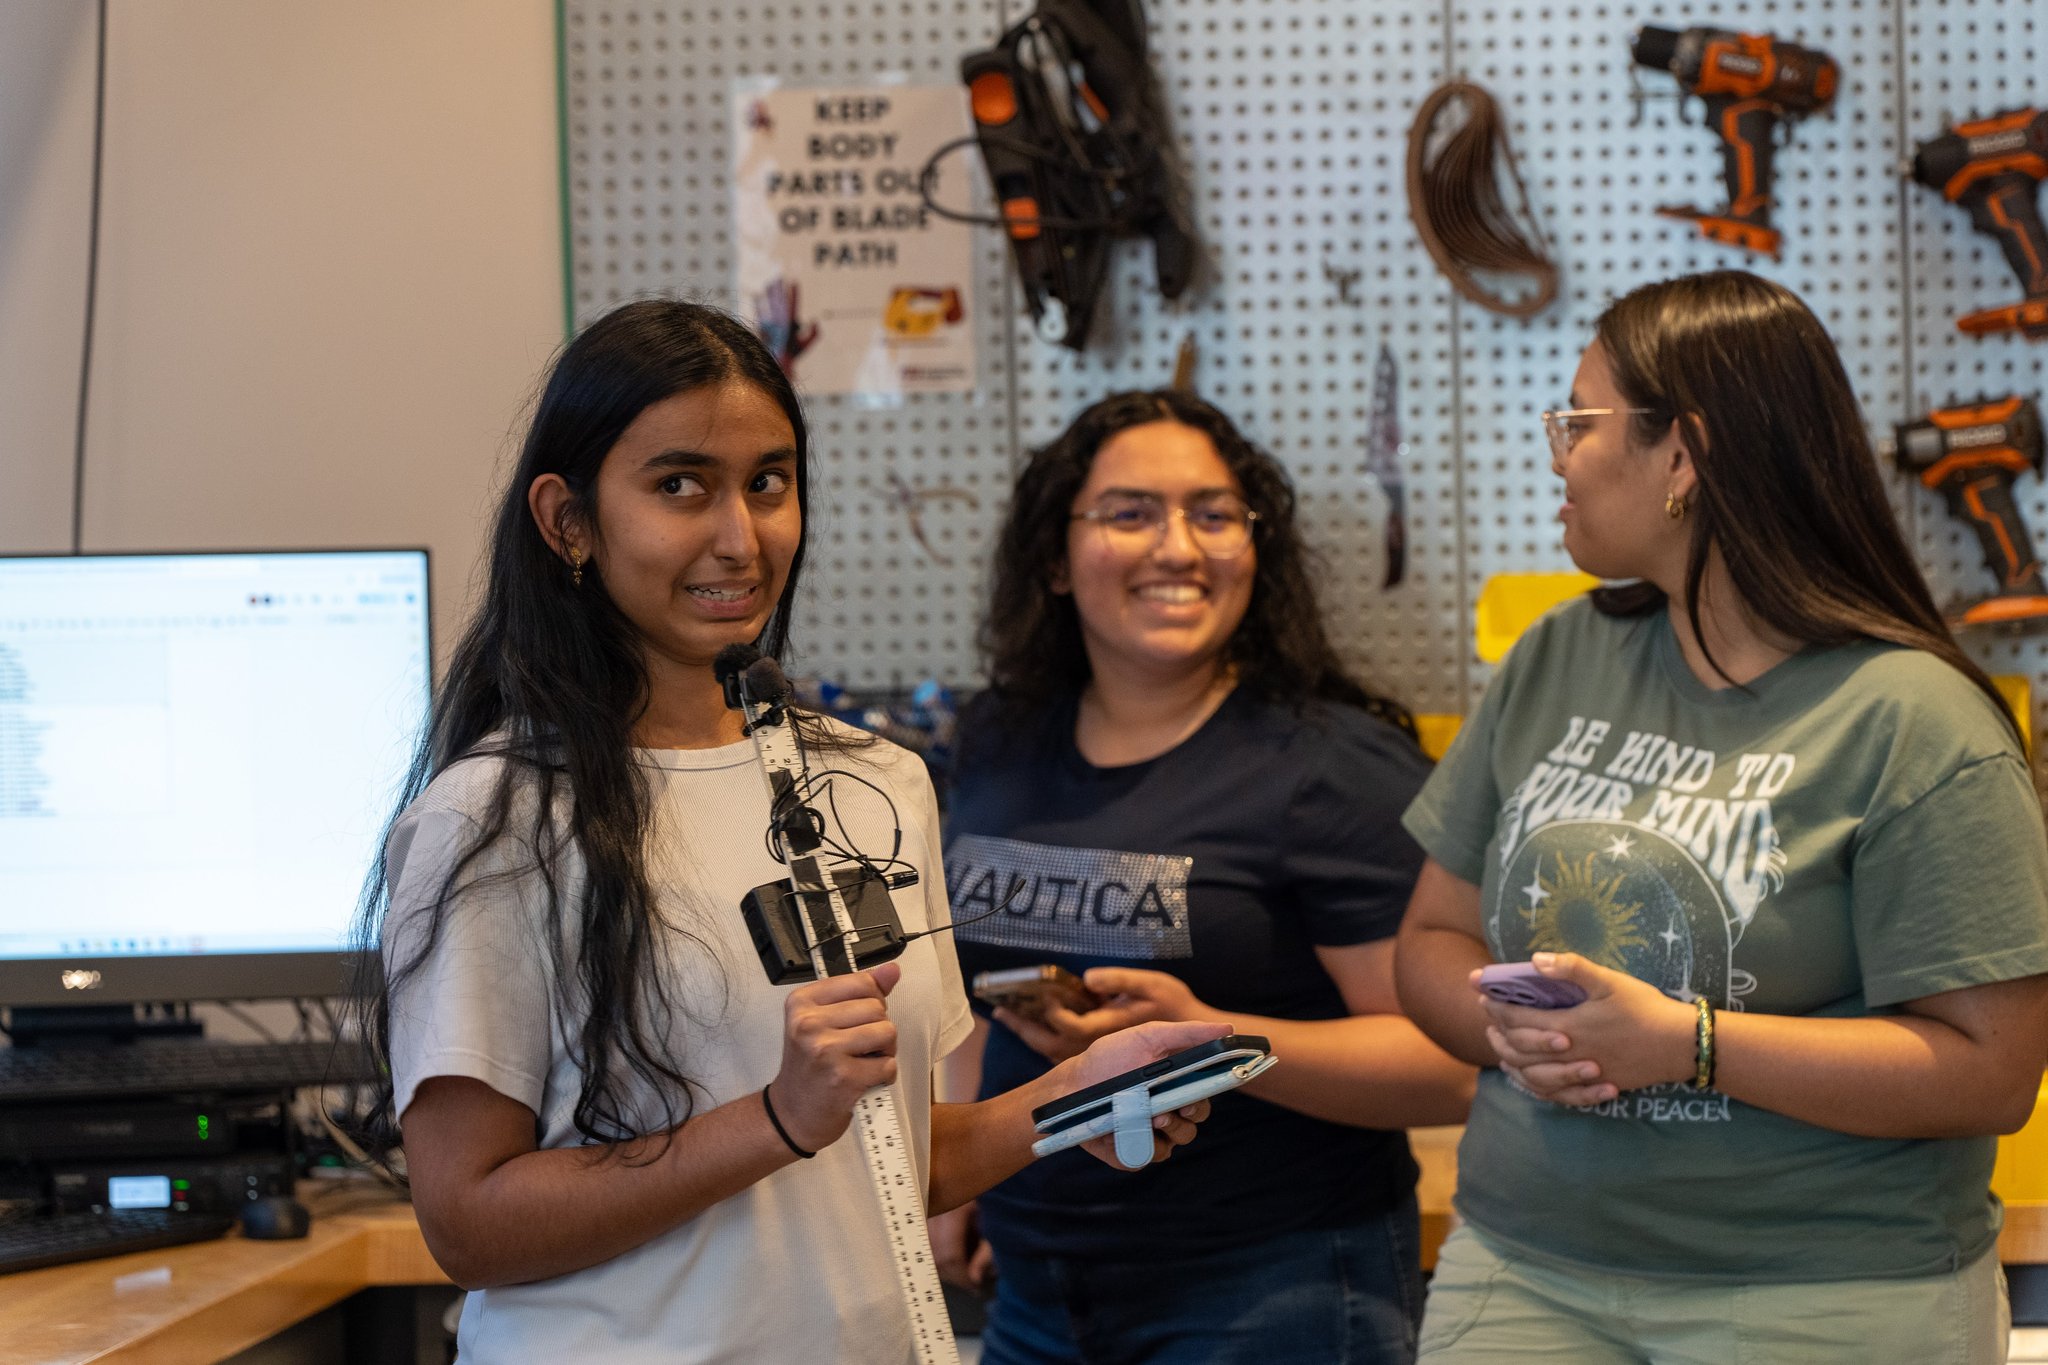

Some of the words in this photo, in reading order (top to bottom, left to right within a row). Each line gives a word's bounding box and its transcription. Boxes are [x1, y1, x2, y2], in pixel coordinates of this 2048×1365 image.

[815, 97, 891, 123] KEEP
[808, 135, 896, 159] BODY
[768, 171, 864, 194] PARTS
[779, 208, 820, 232] OF
[832, 208, 930, 231] BLADE
[815, 243, 897, 266] PATH
[1604, 731, 1715, 793] KIND
[1728, 753, 1796, 798] TO
[1502, 762, 1633, 868] YOUR
[1639, 790, 1774, 925] MIND
